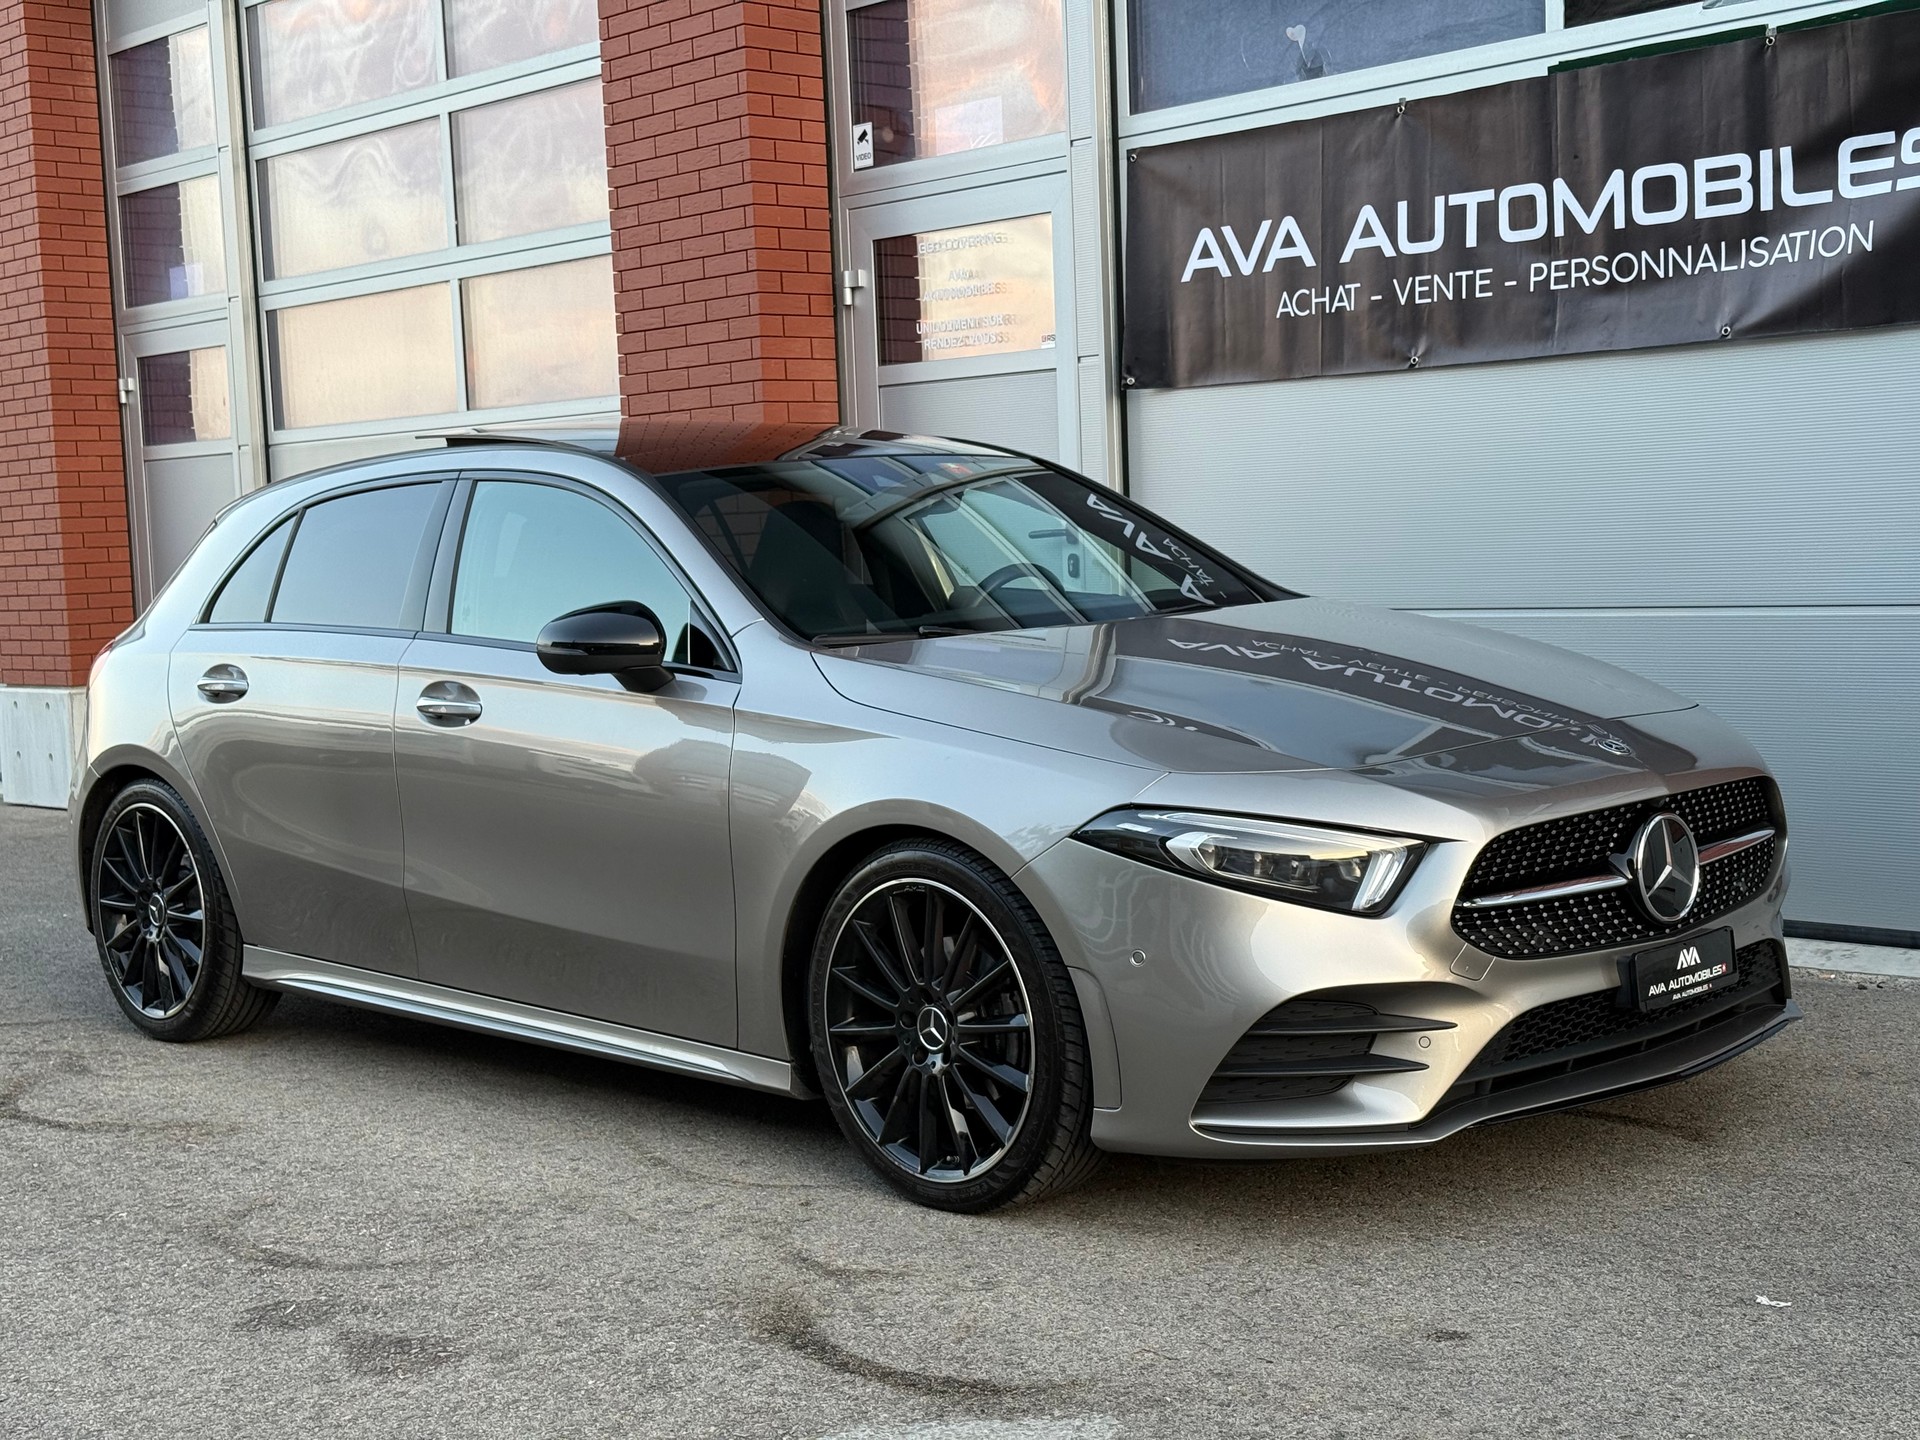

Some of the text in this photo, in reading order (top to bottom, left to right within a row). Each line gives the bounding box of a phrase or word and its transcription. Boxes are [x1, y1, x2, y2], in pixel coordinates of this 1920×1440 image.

[856, 152, 872, 161] VIDEO
[1180, 215, 1317, 283] AVA
[1276, 282, 1361, 319] ACHAT
[1392, 267, 1493, 306] VENTE
[1529, 219, 1875, 293] PERSONNALISATION
[1648, 964, 1723, 997] AVA AUTOMOBILES
